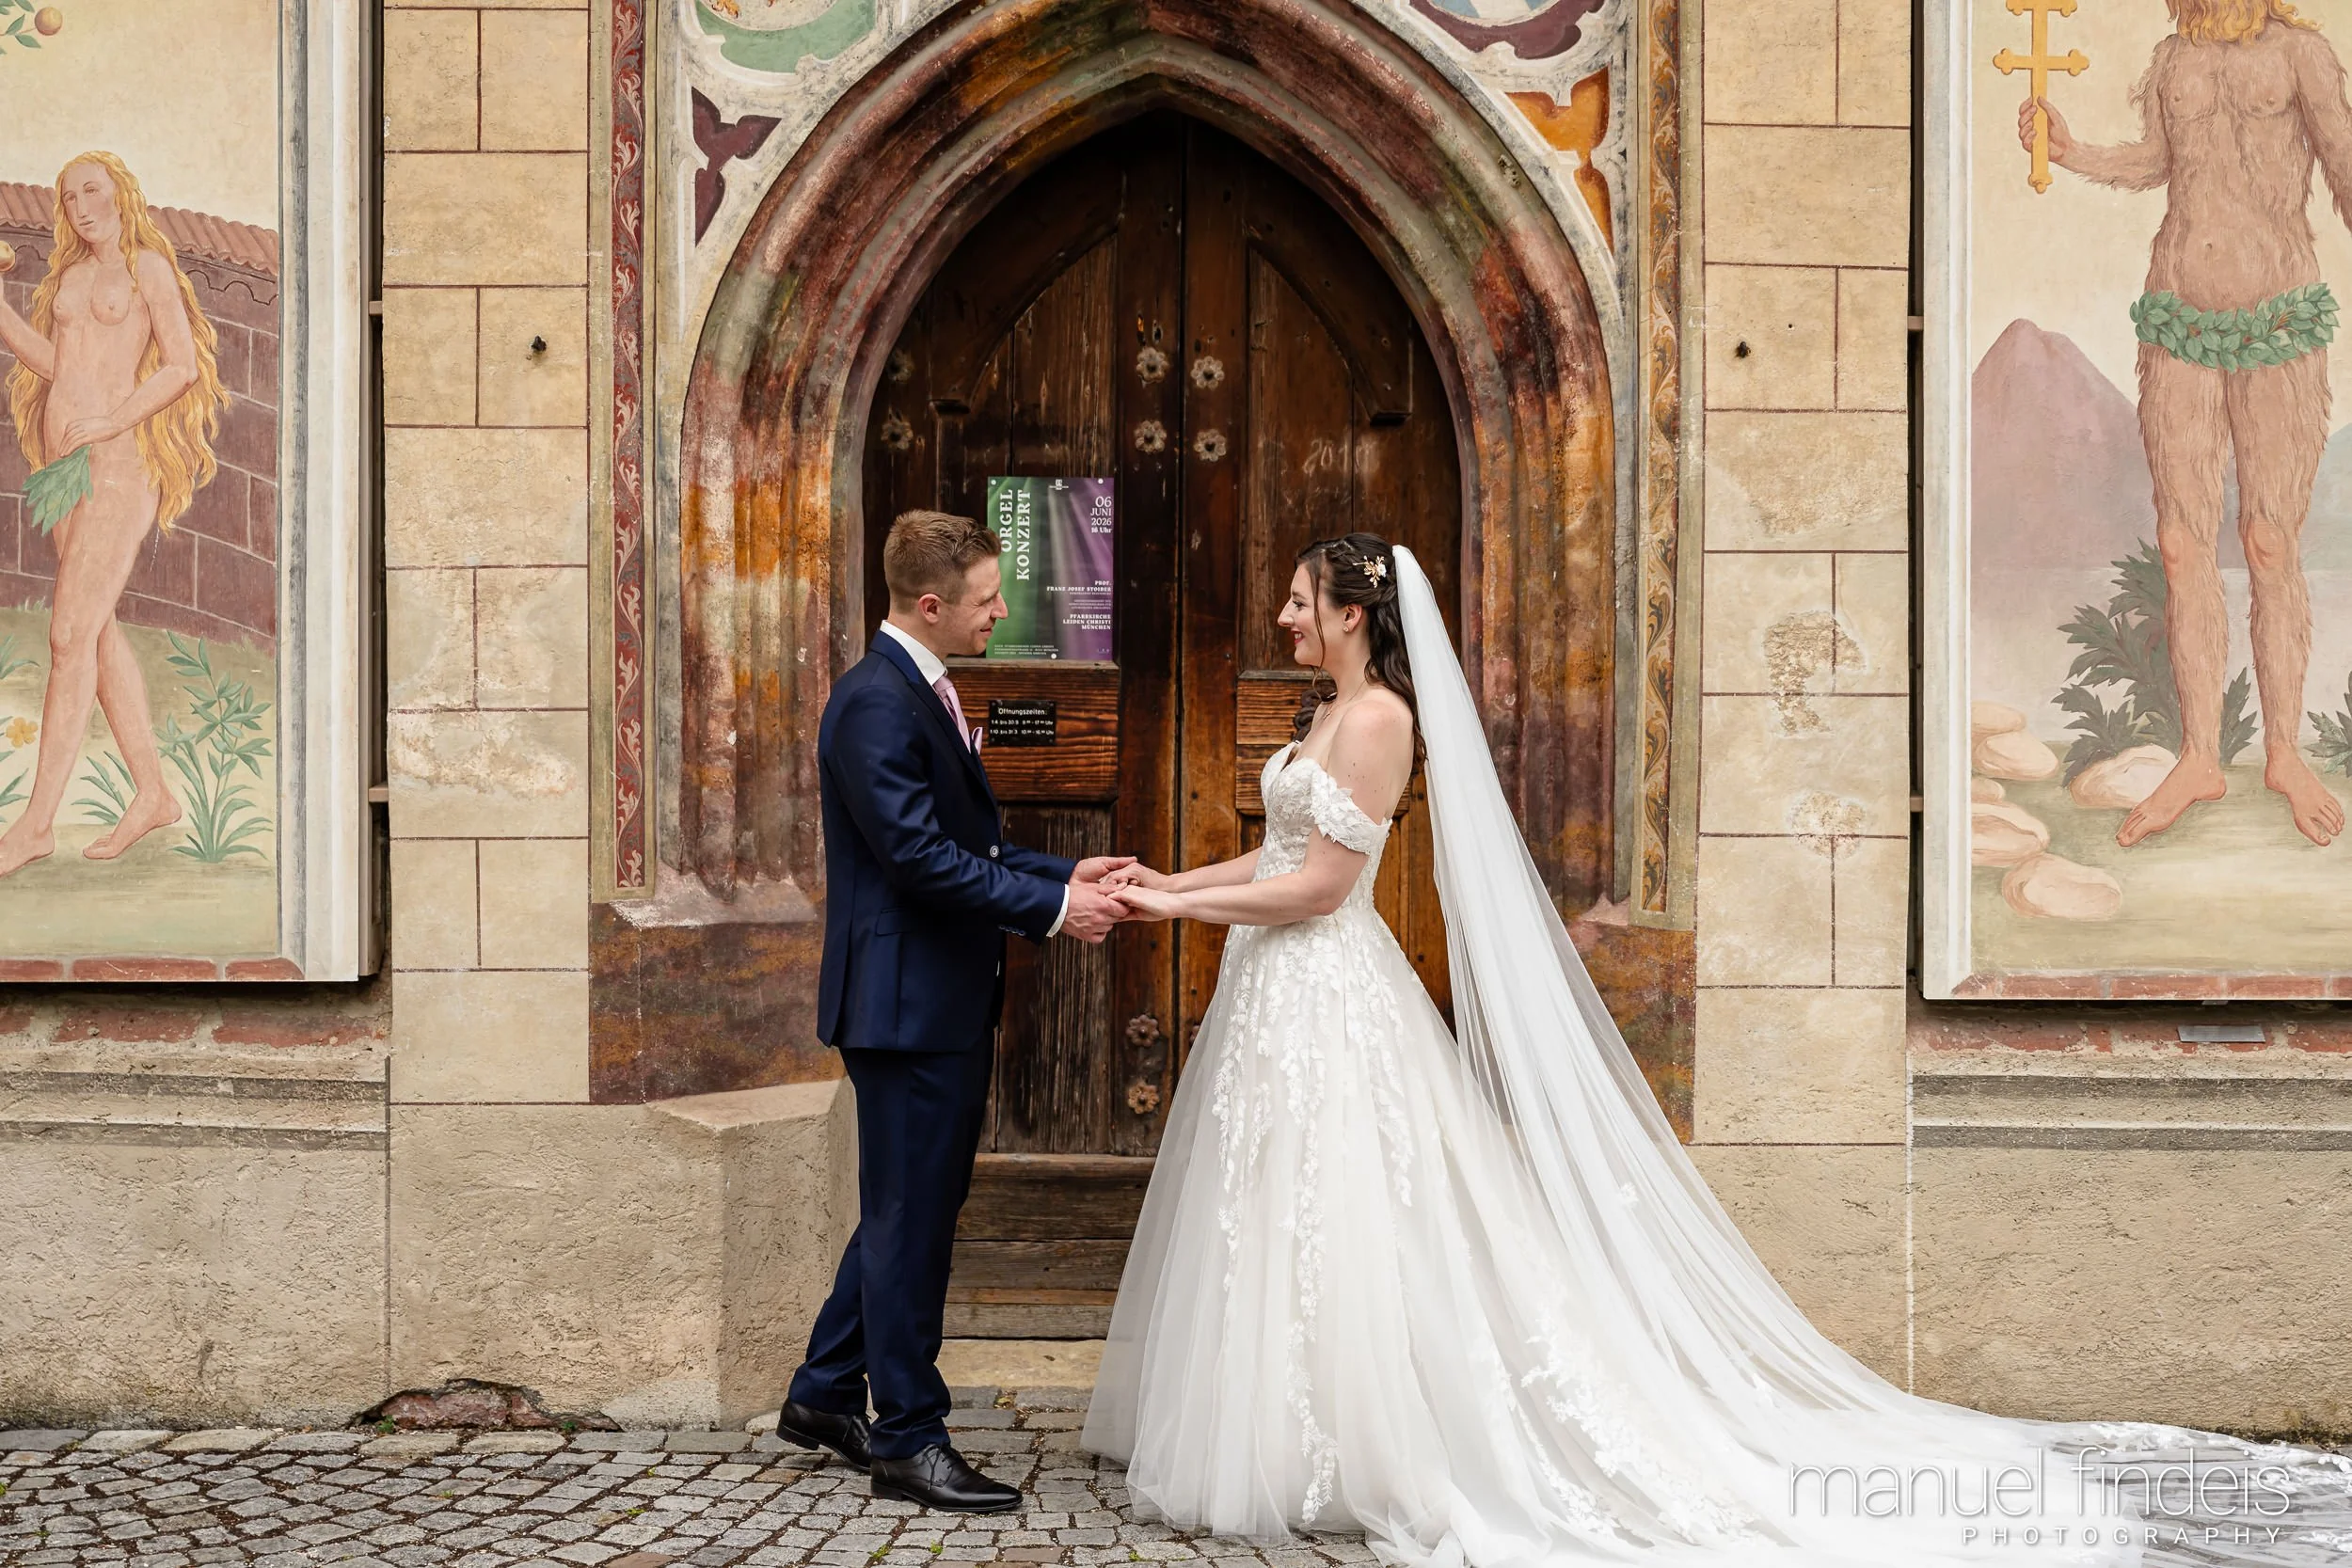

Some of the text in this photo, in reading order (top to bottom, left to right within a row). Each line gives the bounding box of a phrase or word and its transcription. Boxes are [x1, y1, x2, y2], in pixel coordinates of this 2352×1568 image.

[1095, 496, 1112, 508] 06
[1090, 508, 1112, 516] JUNI
[999, 489, 1013, 553] ORGEL
[1091, 517, 1112, 526] 2026
[1016, 489, 1031, 581] KONZERT
